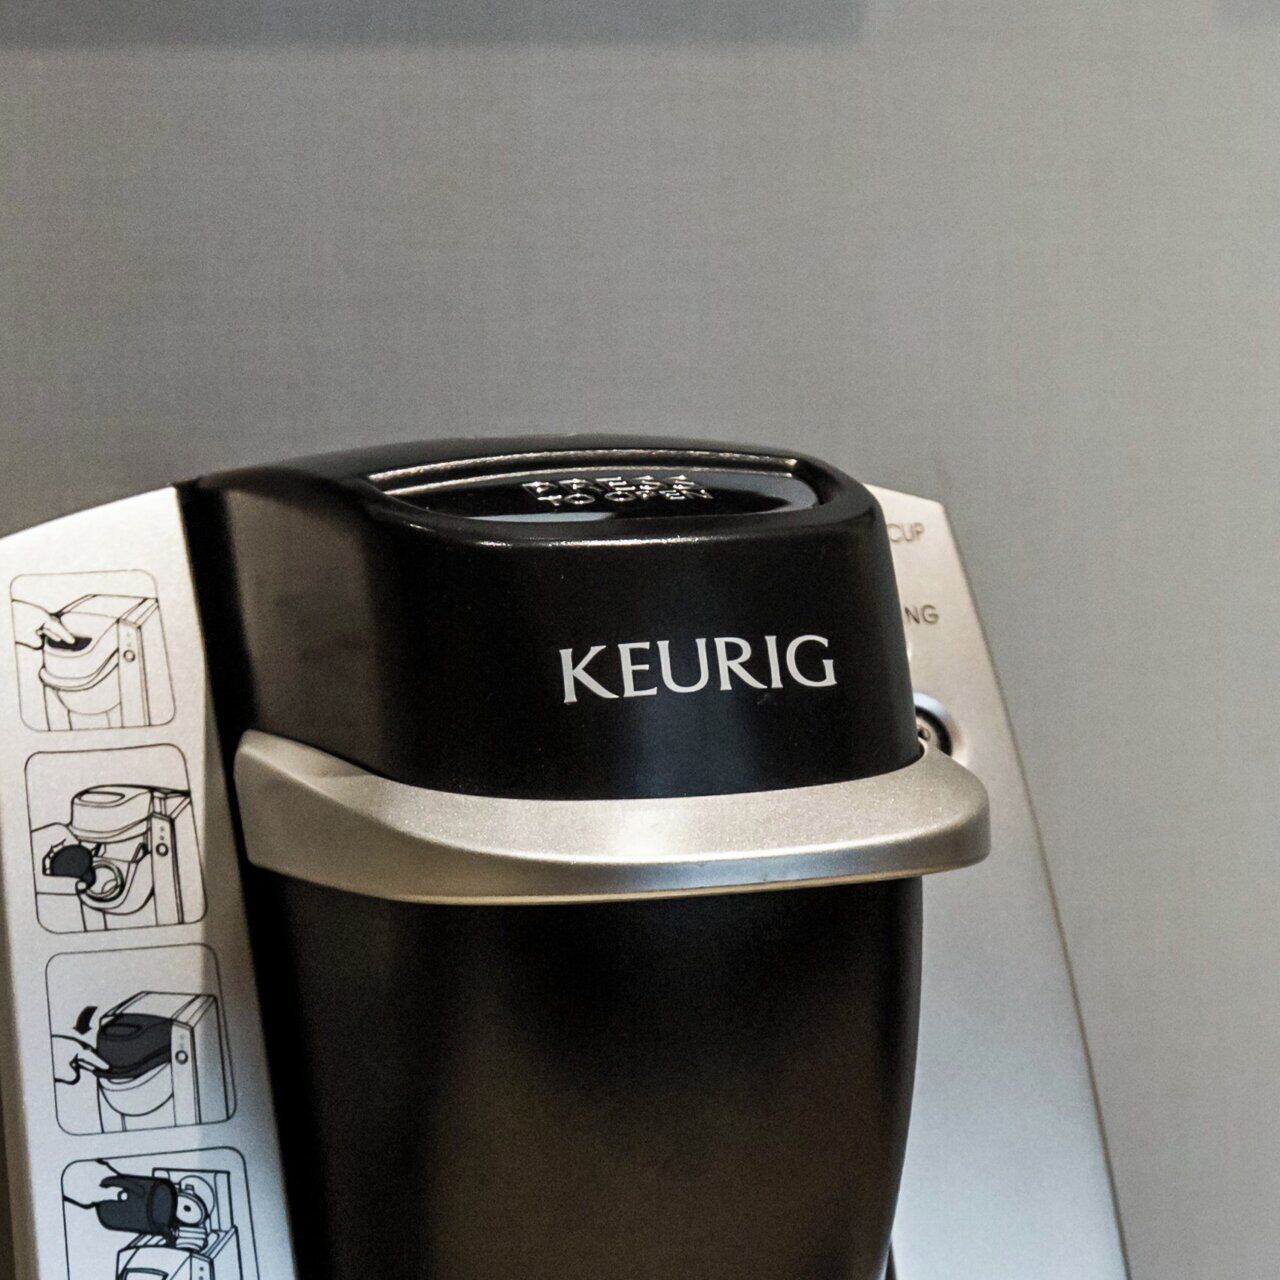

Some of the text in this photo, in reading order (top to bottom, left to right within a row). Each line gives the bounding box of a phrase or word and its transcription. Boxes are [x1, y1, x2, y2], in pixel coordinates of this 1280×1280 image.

[522, 474, 702, 498] PRESS
[537, 492, 596, 507] TO
[559, 634, 838, 704] KEURIG
